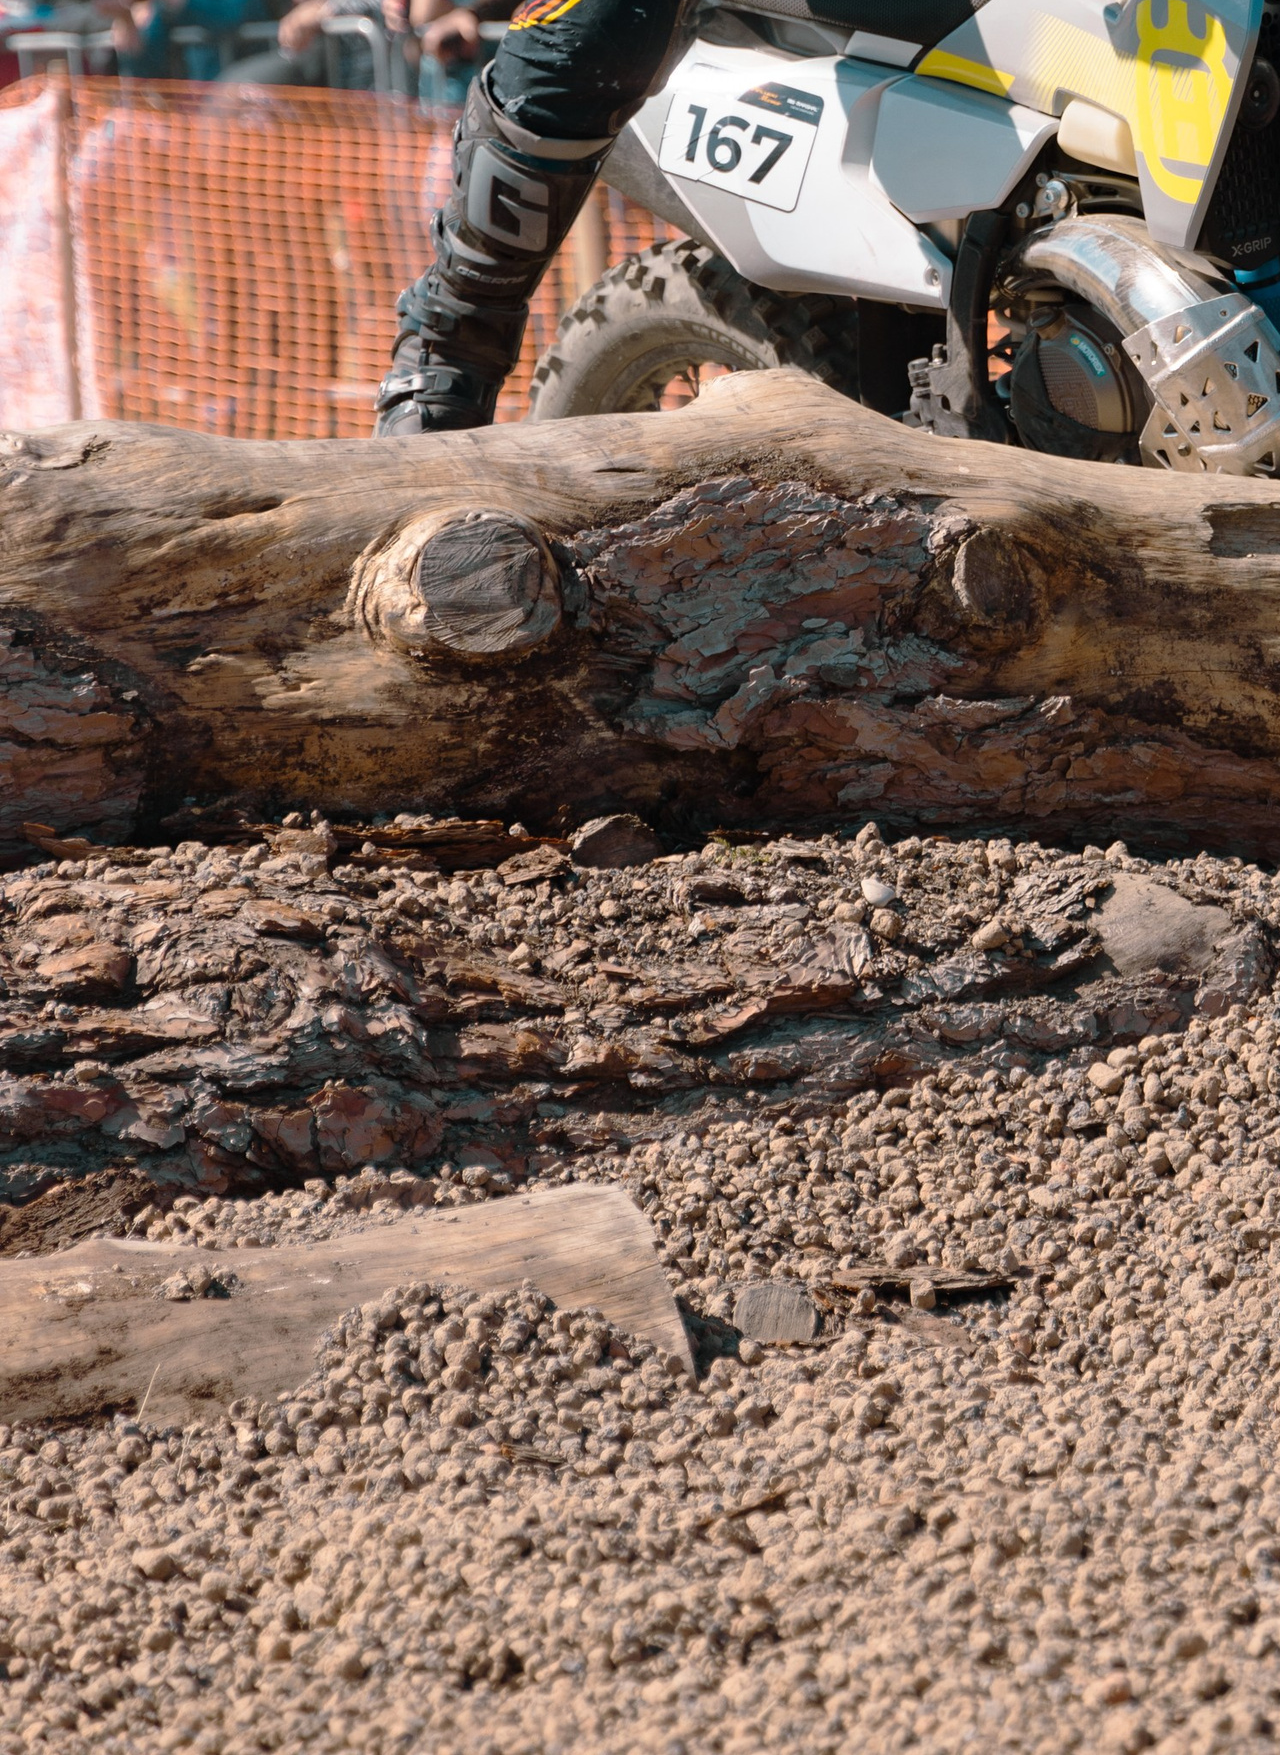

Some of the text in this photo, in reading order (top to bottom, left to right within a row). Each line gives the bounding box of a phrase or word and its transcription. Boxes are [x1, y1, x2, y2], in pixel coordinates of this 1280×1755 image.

[685, 103, 794, 185] 167
[1231, 237, 1272, 257] X-GRIP
[1077, 341, 1105, 375] MOTOREX
